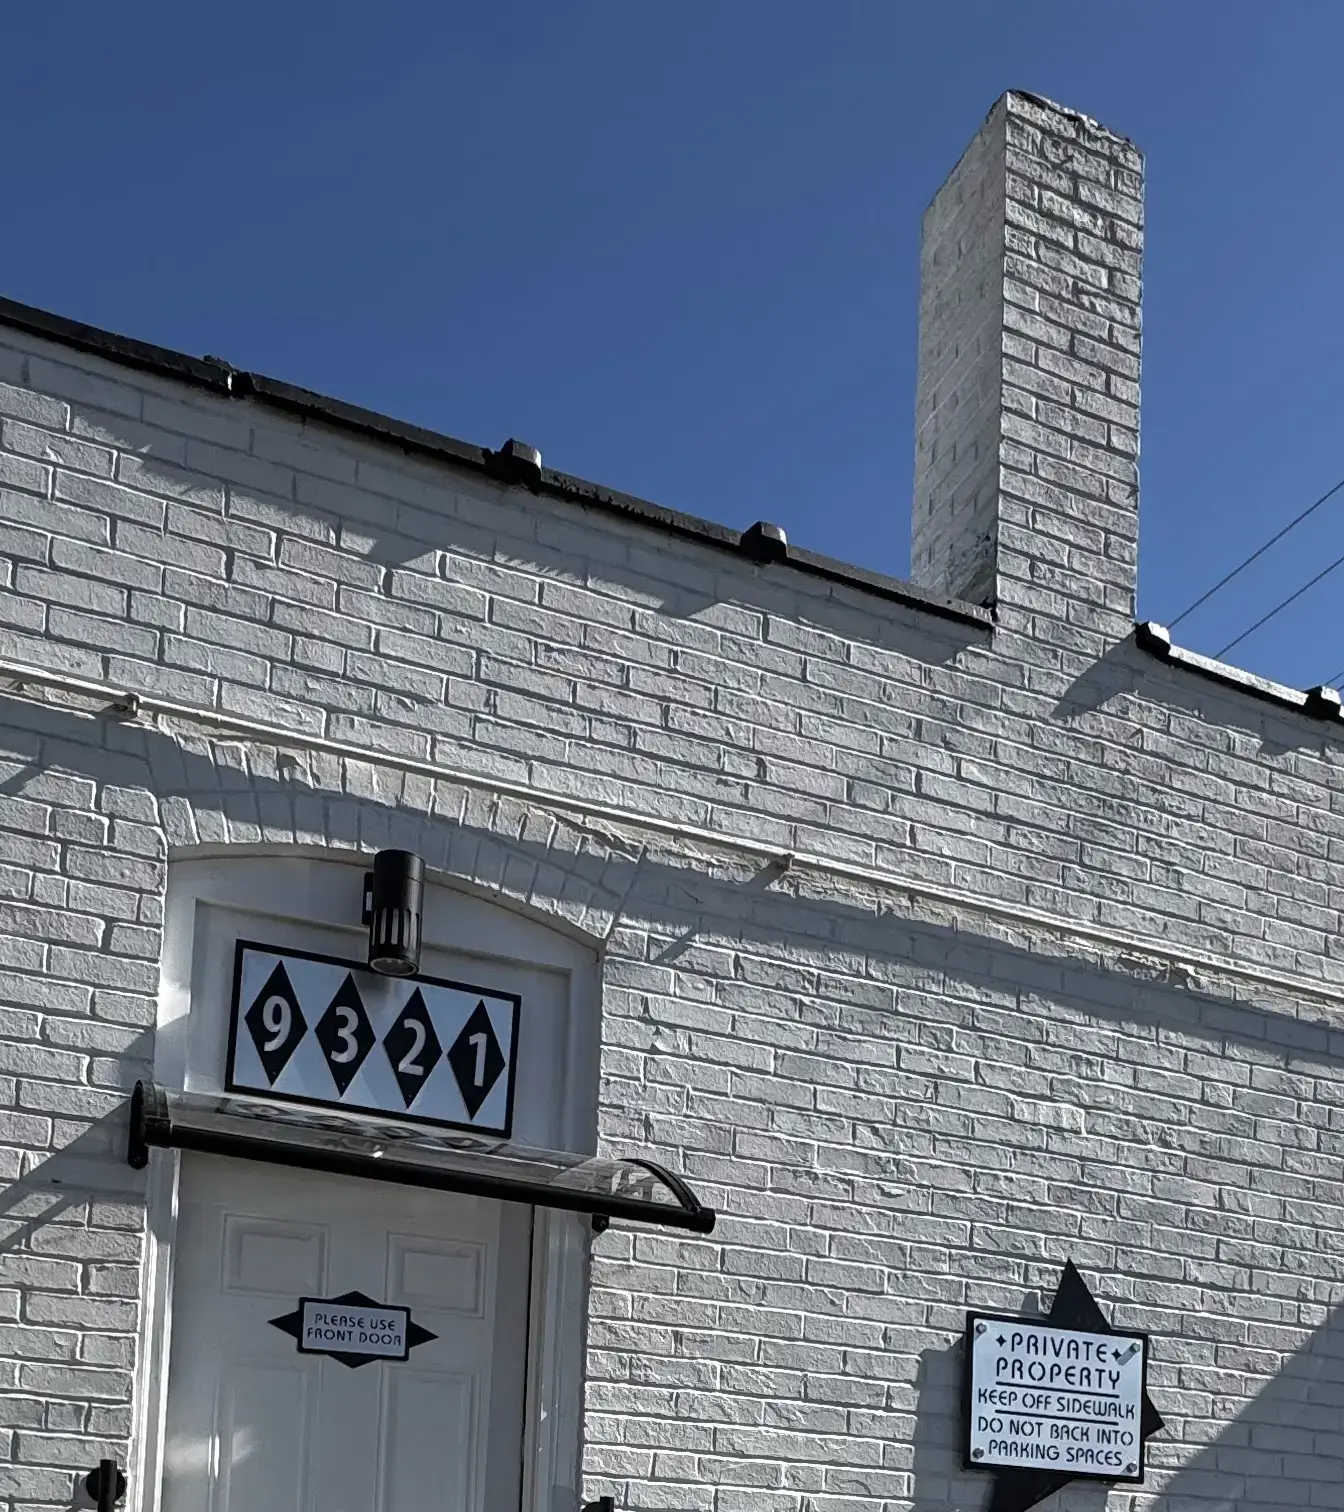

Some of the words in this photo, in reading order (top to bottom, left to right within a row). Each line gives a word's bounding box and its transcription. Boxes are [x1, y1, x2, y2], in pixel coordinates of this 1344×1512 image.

[261, 995, 488, 1087] 9321
[307, 1327, 354, 1342] FRONT
[359, 1333, 402, 1347] DOOR
[314, 1313, 365, 1329] PLEASE
[370, 1318, 396, 1332] USE
[1010, 1332, 1108, 1363] PRIVATE
[995, 1357, 1121, 1390] PROPERTY
[977, 1387, 1017, 1407] KEEP
[1022, 1393, 1052, 1411] OFF
[1056, 1396, 1136, 1420] SIDEWALK
[977, 1416, 1004, 1433] DO
[1009, 1420, 1044, 1437] NOT
[1050, 1424, 1089, 1442] BACK
[1096, 1428, 1134, 1447] INTO
[988, 1439, 1060, 1461] PARKING
[1066, 1447, 1123, 1467] SPACES
